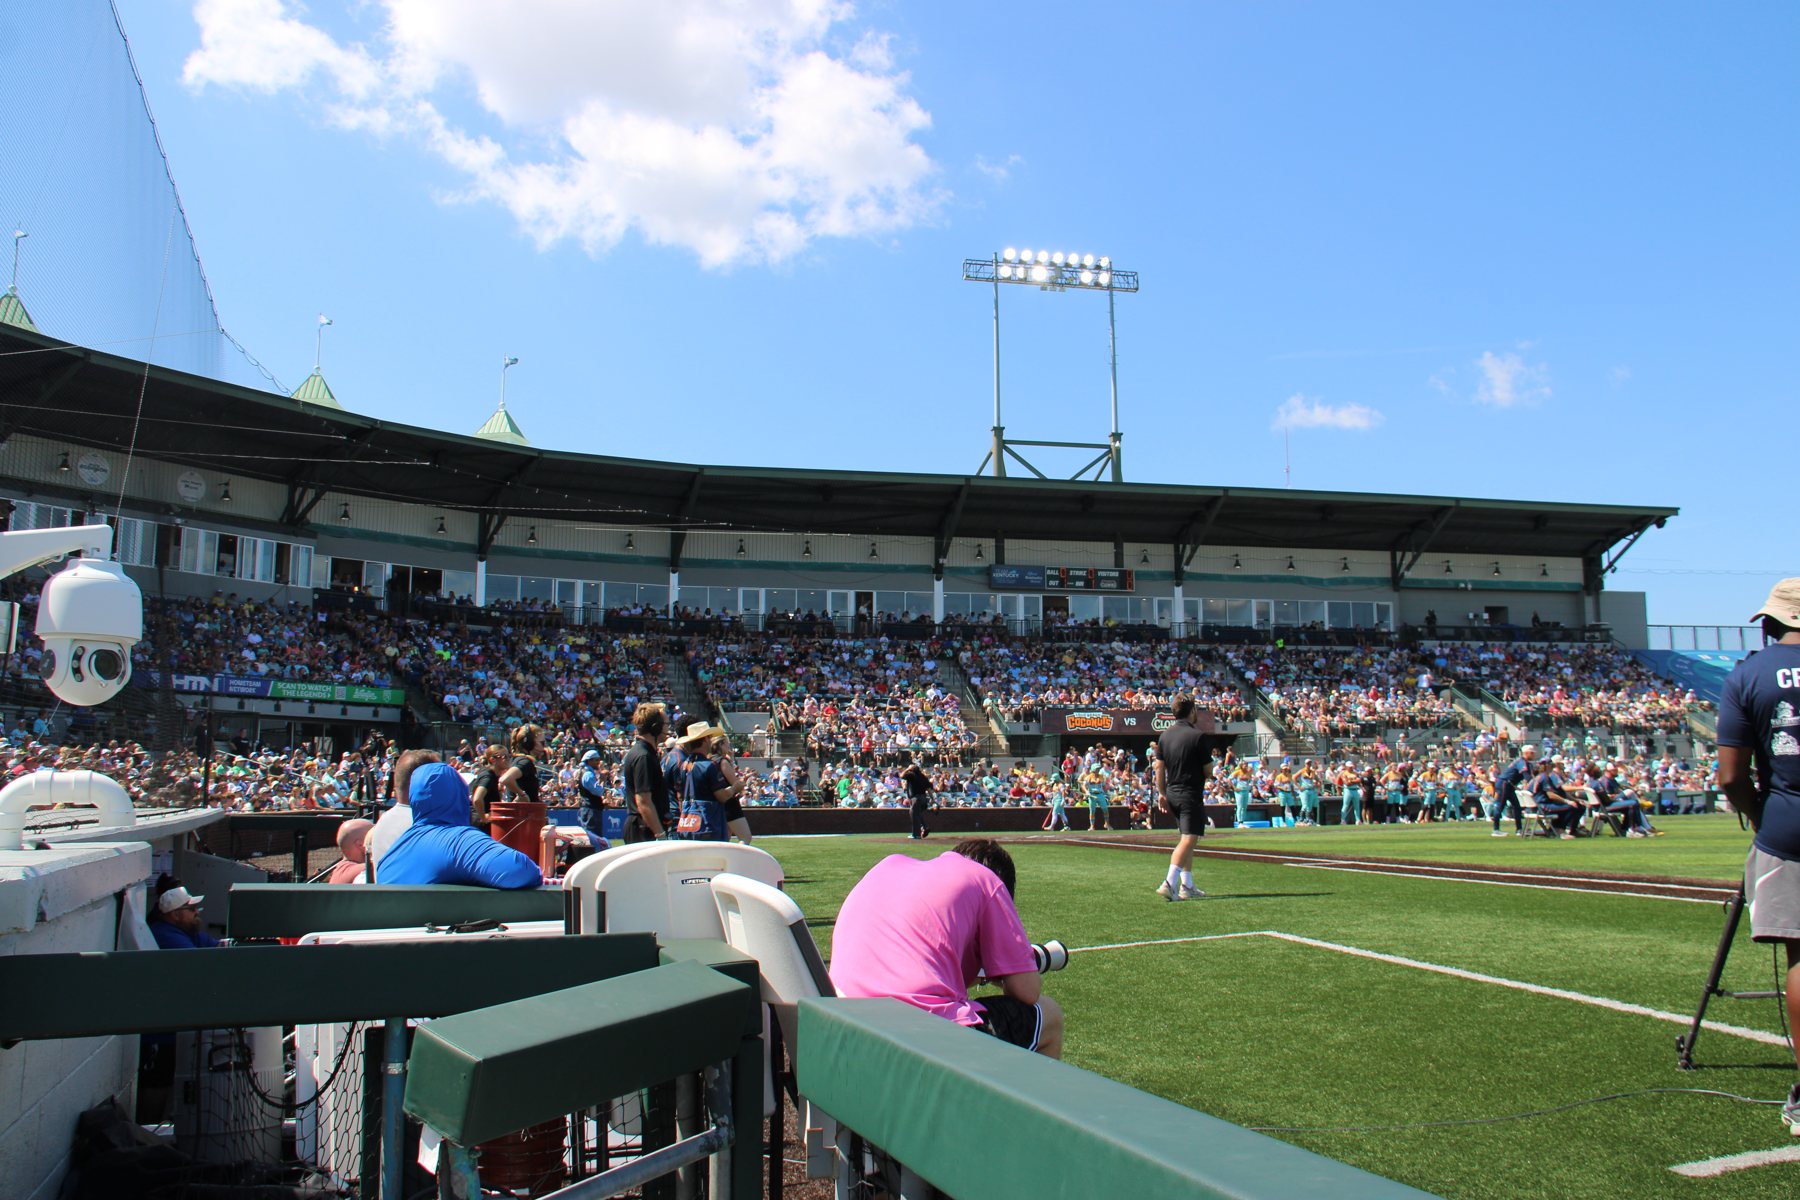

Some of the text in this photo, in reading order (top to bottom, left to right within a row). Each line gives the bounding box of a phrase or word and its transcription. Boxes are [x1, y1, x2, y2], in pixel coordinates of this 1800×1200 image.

[229, 679, 261, 687] HOMETEAM
[229, 686, 256, 694] NETWORK
[307, 683, 332, 692] WATCH
[295, 690, 327, 698] LEGENDS
[1068, 716, 1111, 729] COCONUTS
[1123, 717, 1136, 726] VS
